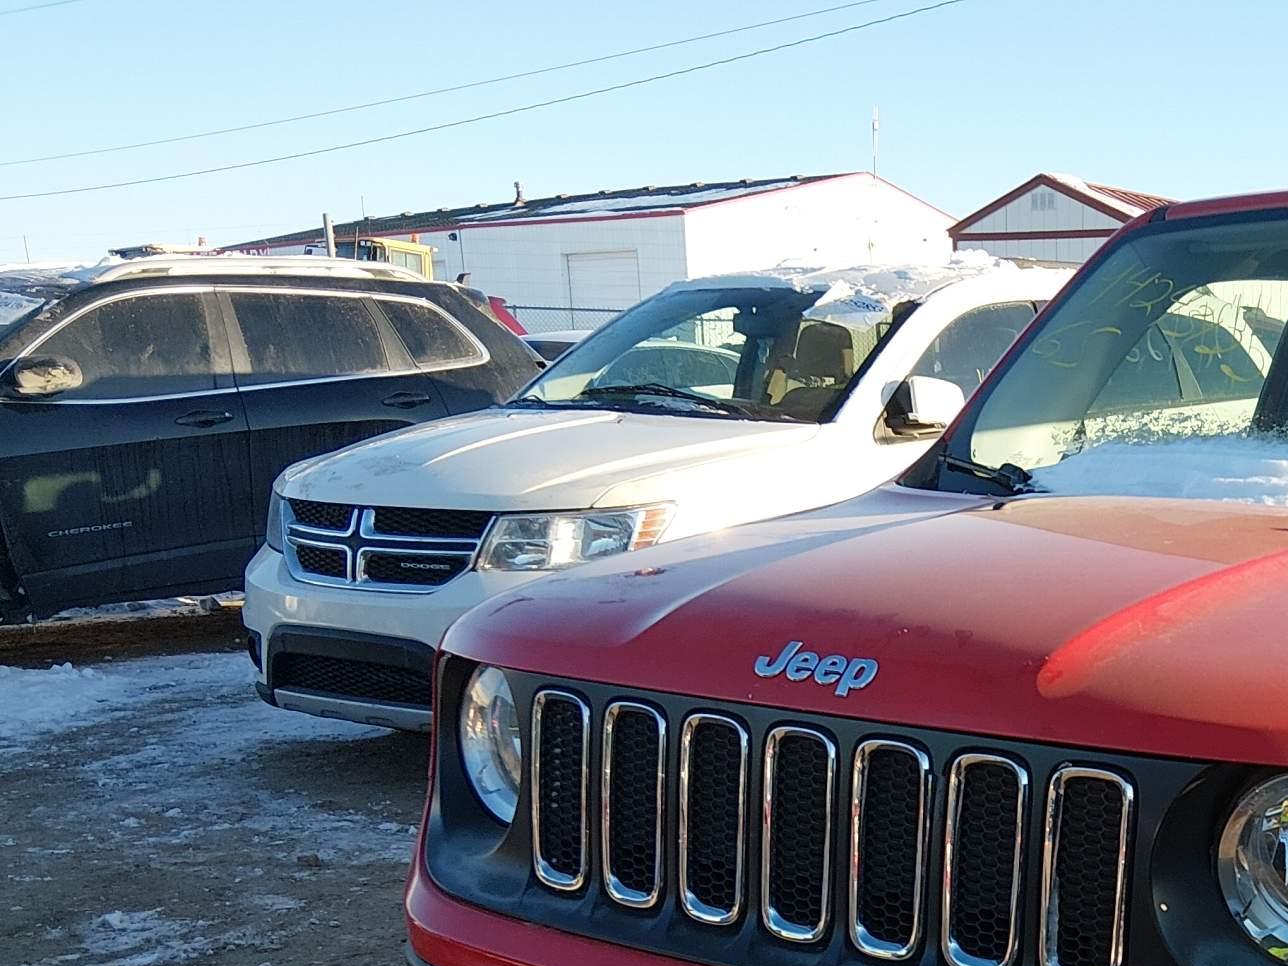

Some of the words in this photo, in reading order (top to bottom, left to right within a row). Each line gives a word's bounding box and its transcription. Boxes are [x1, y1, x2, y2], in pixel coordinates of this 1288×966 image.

[48, 520, 133, 537] CHEROKEE
[400, 562, 451, 570] DODGE
[754, 640, 879, 697] Jeep
